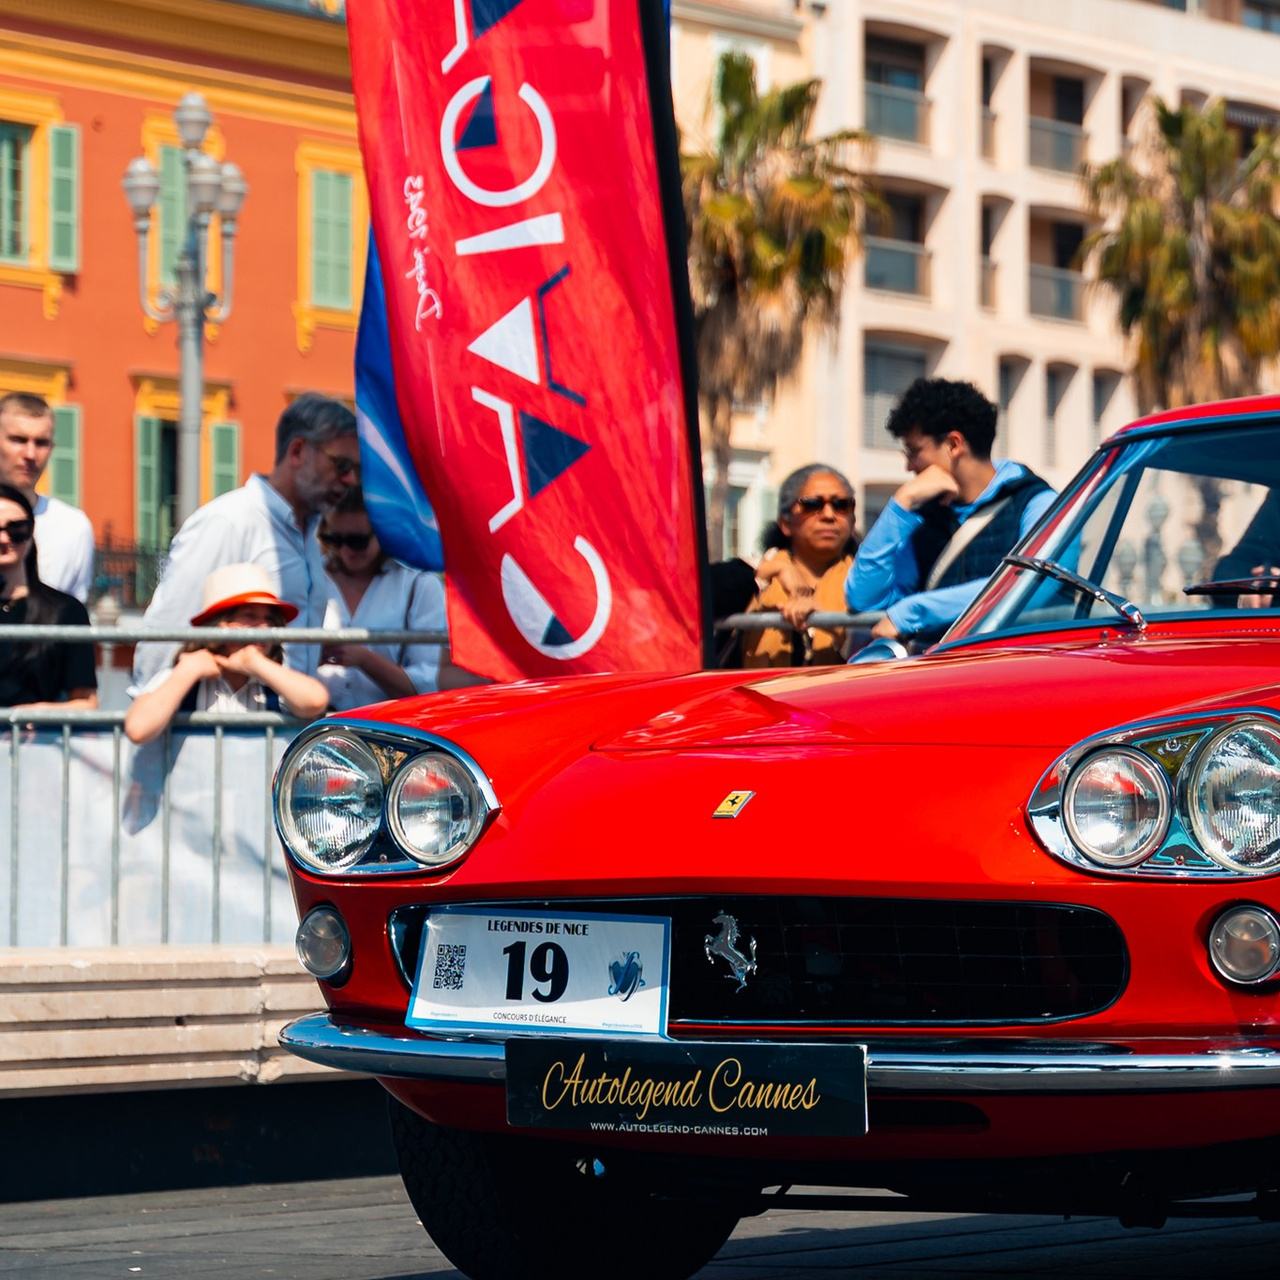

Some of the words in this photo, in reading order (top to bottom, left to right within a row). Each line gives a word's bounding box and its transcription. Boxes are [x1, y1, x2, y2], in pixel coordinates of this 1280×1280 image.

[487, 920, 543, 934] LEGENDES
[546, 923, 561, 935] DE
[563, 923, 589, 936] NICE
[502, 940, 570, 1003] 19
[493, 1012, 528, 1022] CONCOURS
[542, 1053, 703, 1120] Autolegend
[709, 1058, 821, 1112] Cannes
[590, 1122, 768, 1136] WWW.AUTOLEGEND-CANNES.COM
